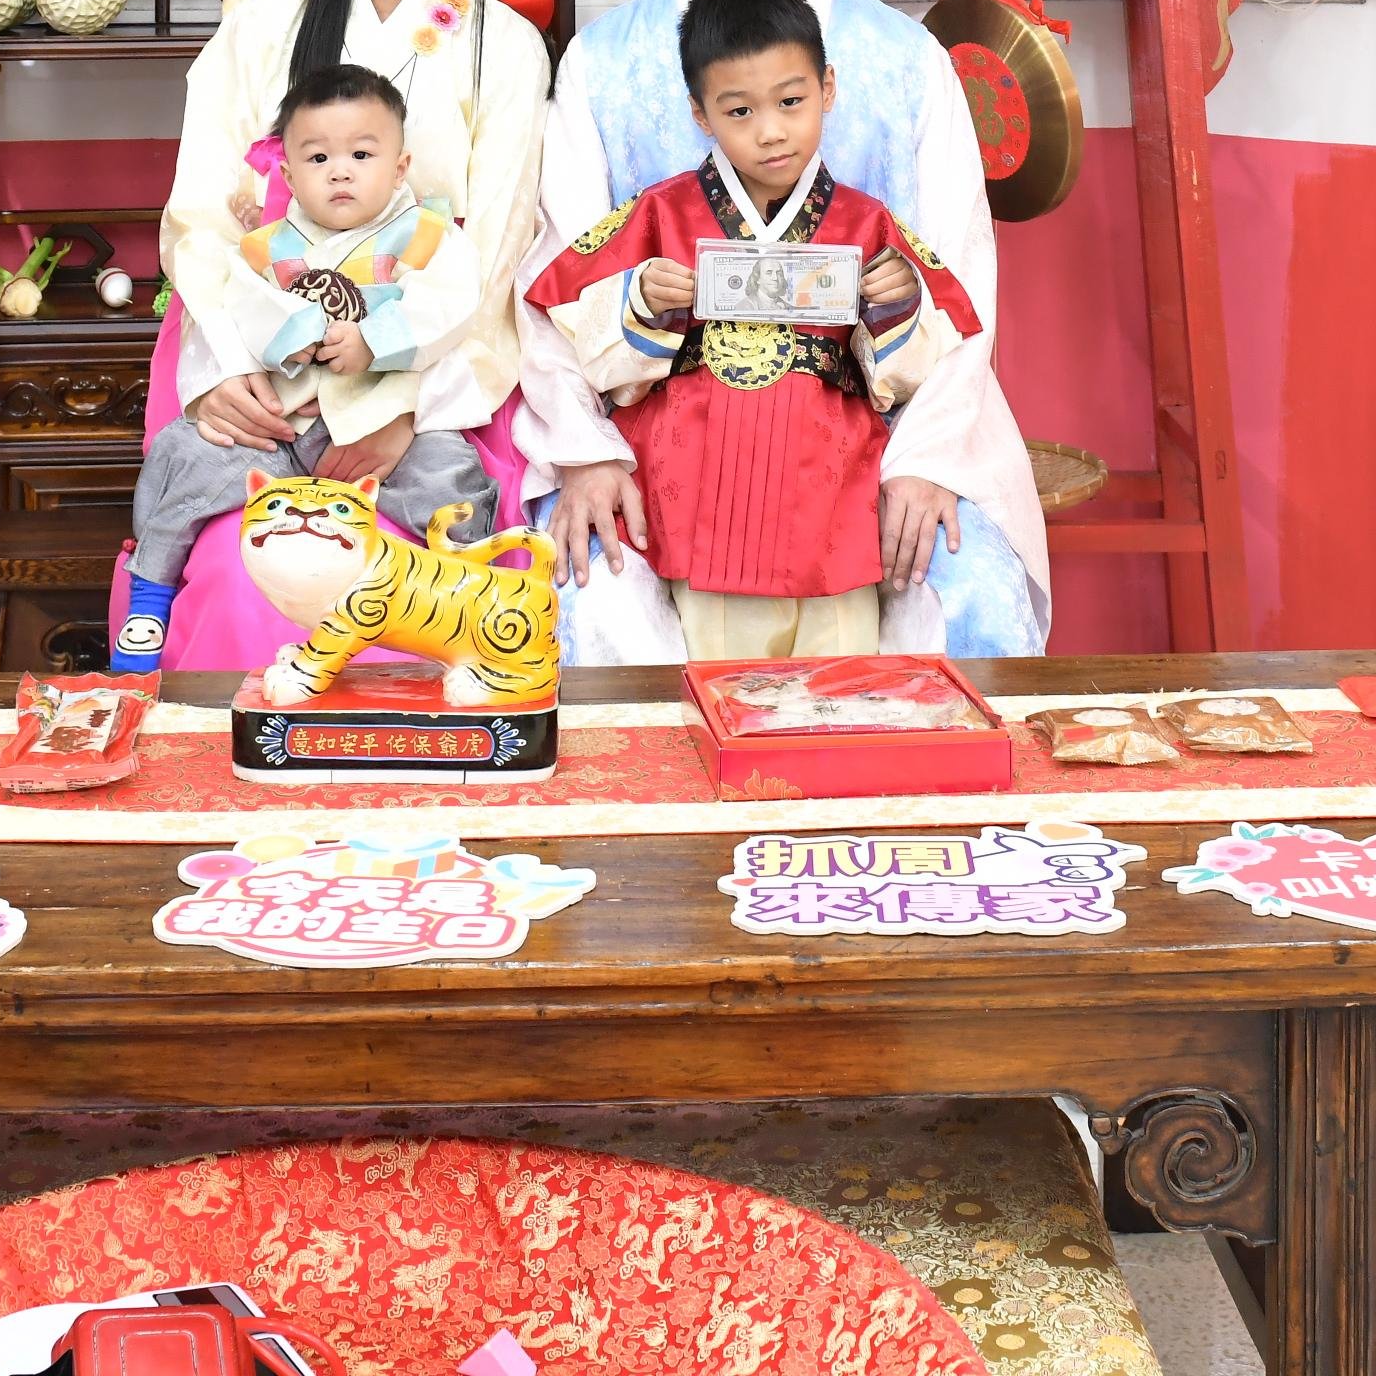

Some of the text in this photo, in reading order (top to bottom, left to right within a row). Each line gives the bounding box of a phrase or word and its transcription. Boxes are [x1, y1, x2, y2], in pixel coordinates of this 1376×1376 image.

[747, 839, 976, 878] 抓周
[239, 871, 499, 916] 今天是
[745, 883, 1112, 924] 來傳家
[172, 898, 511, 947] 我的生日
